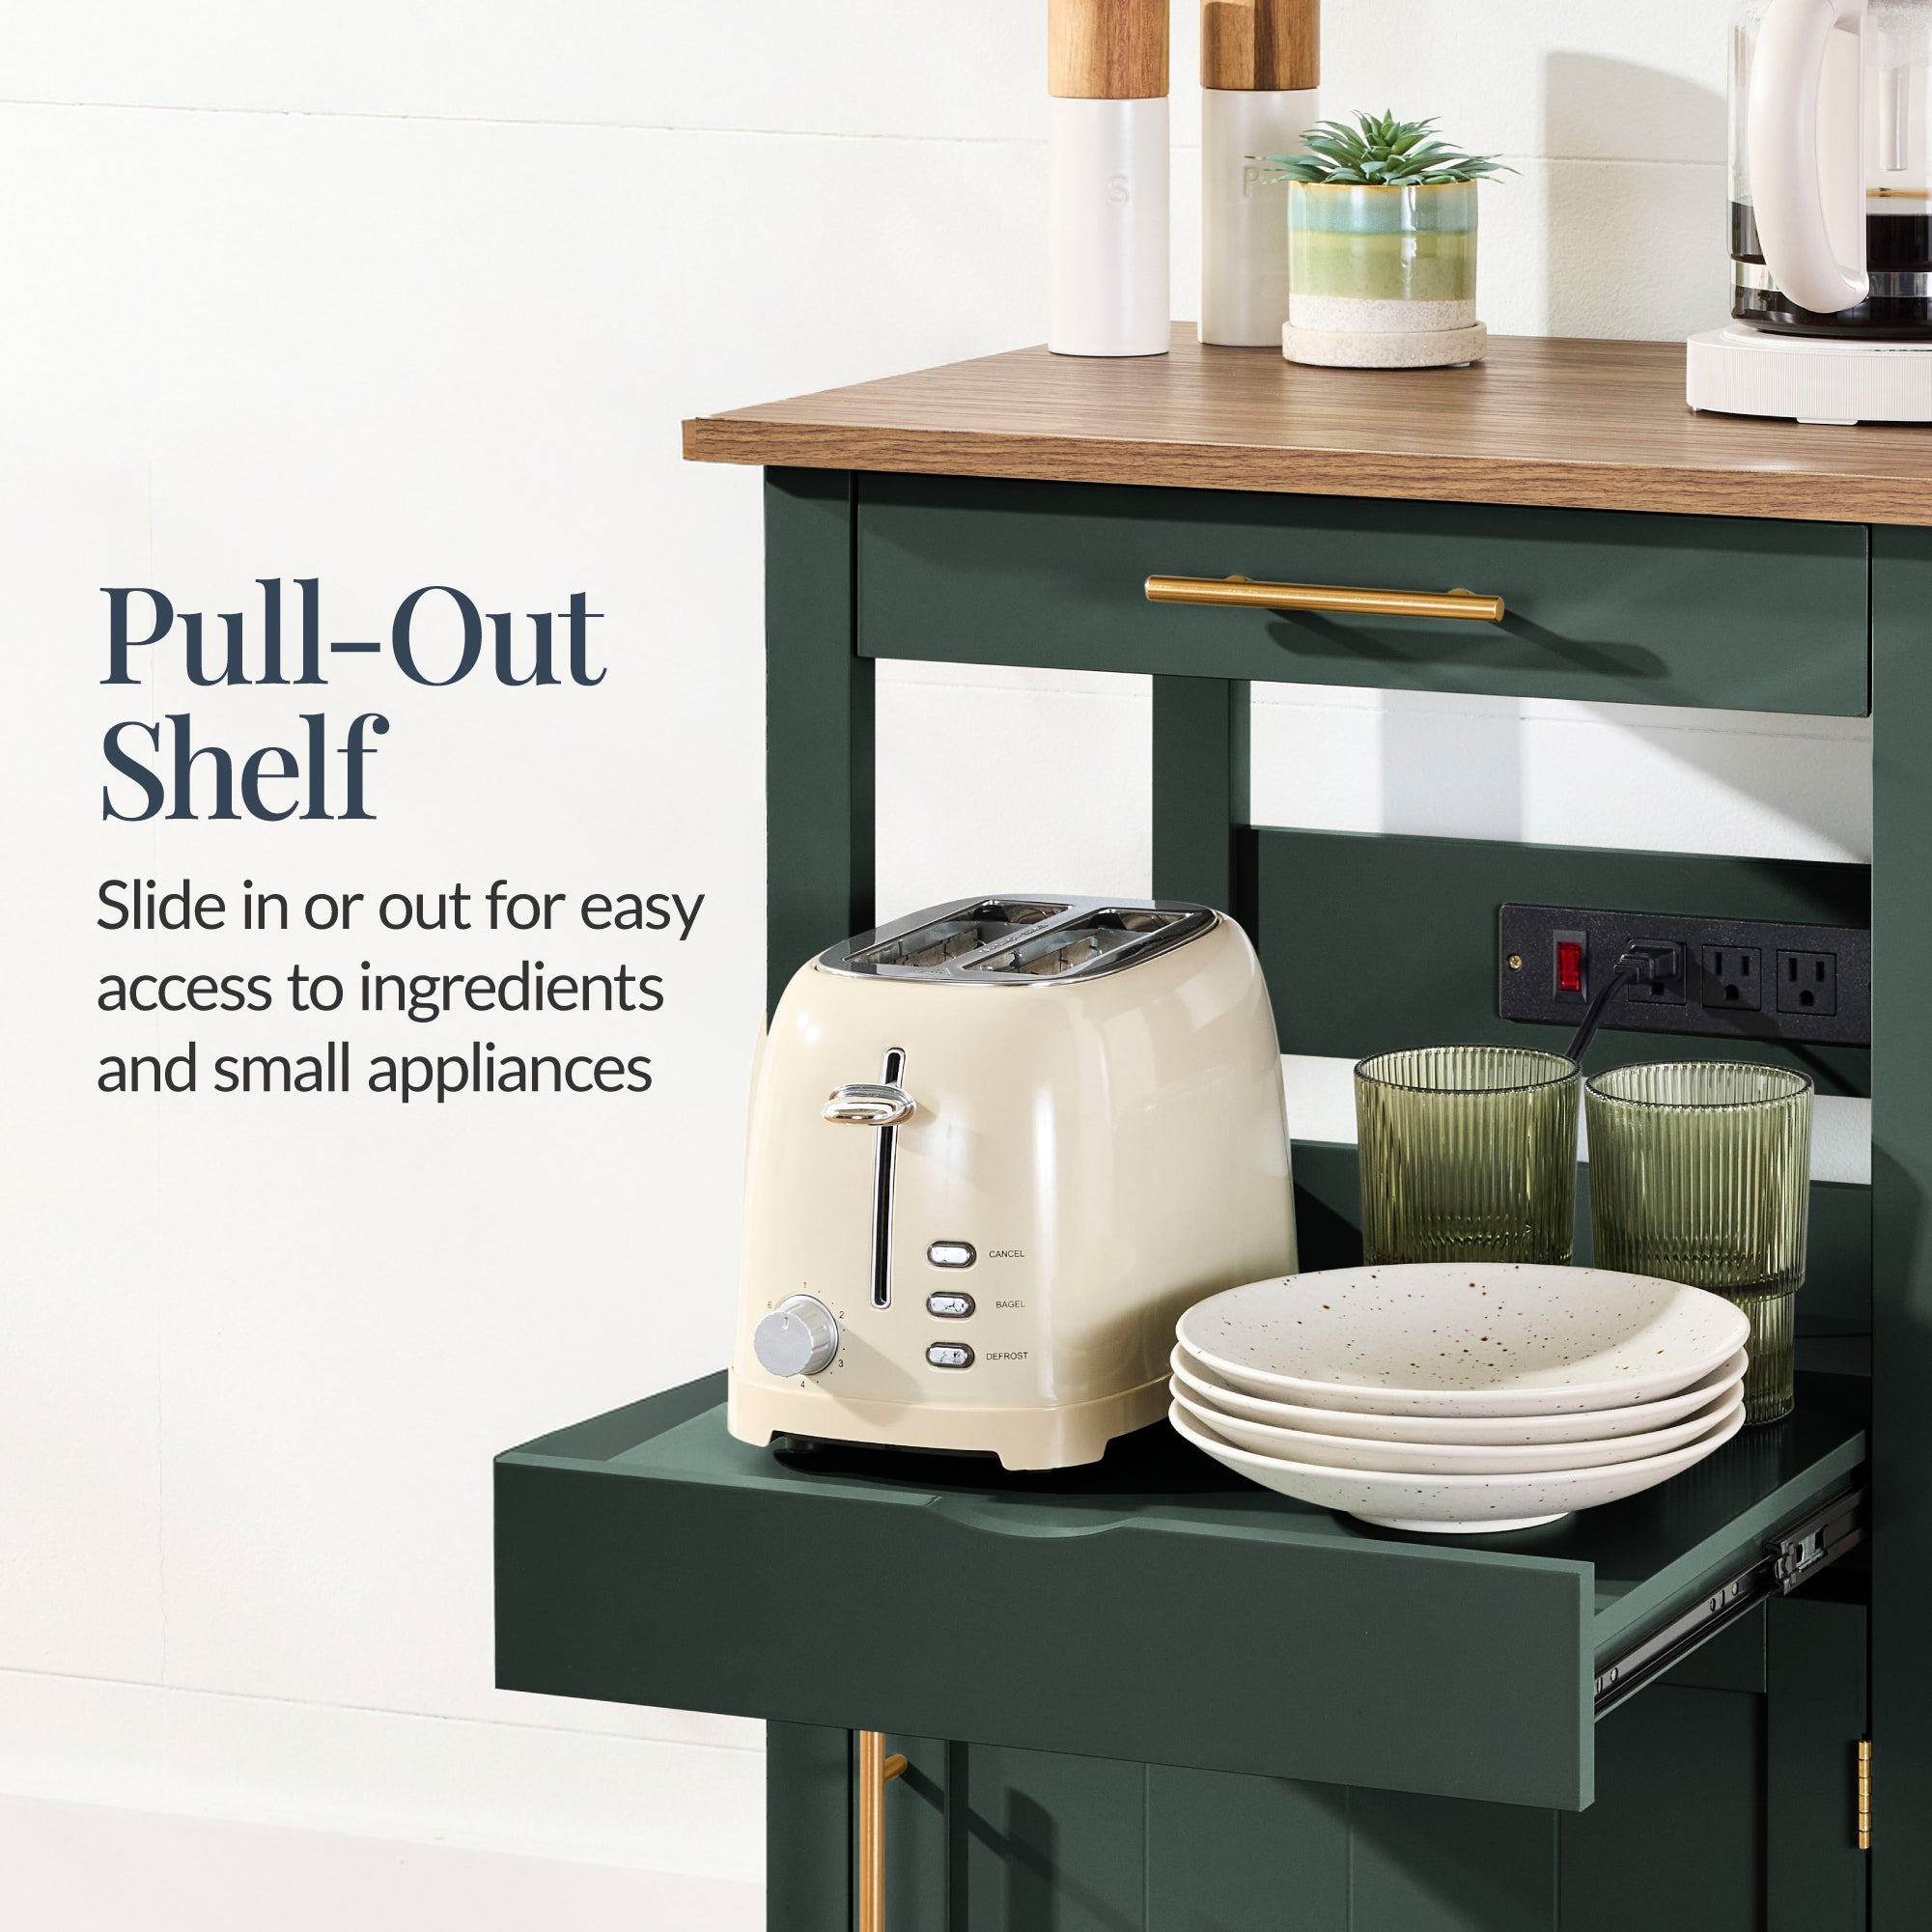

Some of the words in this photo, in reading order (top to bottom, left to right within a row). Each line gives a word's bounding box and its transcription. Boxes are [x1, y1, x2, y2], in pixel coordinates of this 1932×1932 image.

[1242, 165, 1261, 199] P
[1107, 174, 1131, 205] S
[989, 1249, 1025, 1258] CANCEL
[767, 1301, 772, 1309] 6
[995, 1301, 1025, 1309] BAGEL
[838, 1310, 845, 1319] 2
[986, 1352, 1028, 1360] DEFROST
[838, 1359, 844, 1368] 3
[799, 1380, 806, 1388] 4
